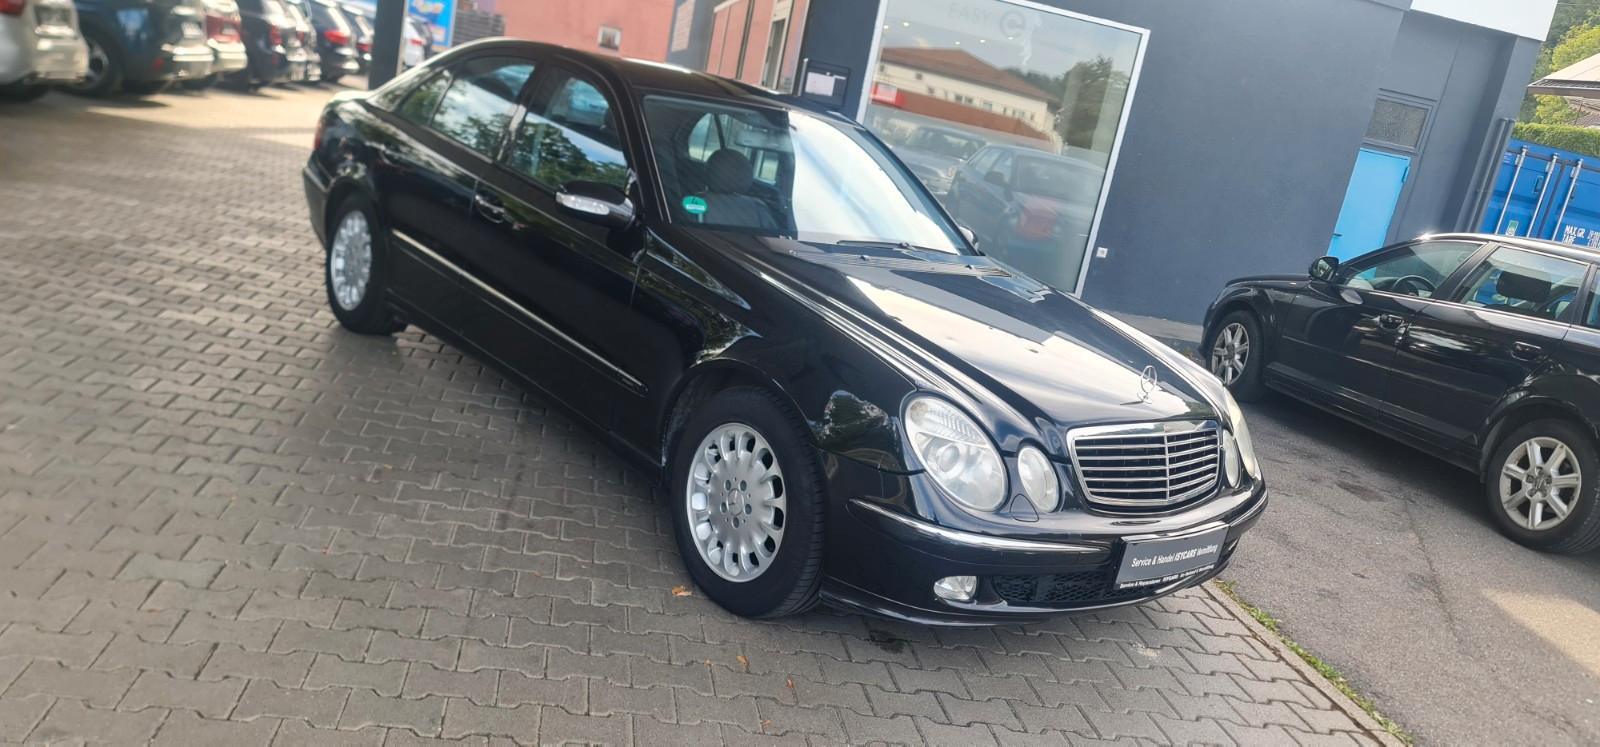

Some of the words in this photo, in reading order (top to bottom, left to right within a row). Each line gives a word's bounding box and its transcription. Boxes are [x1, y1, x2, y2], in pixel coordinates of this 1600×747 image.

[1131, 557, 1152, 567] Service
[1151, 555, 1157, 565] &
[1157, 553, 1174, 564] Handel
